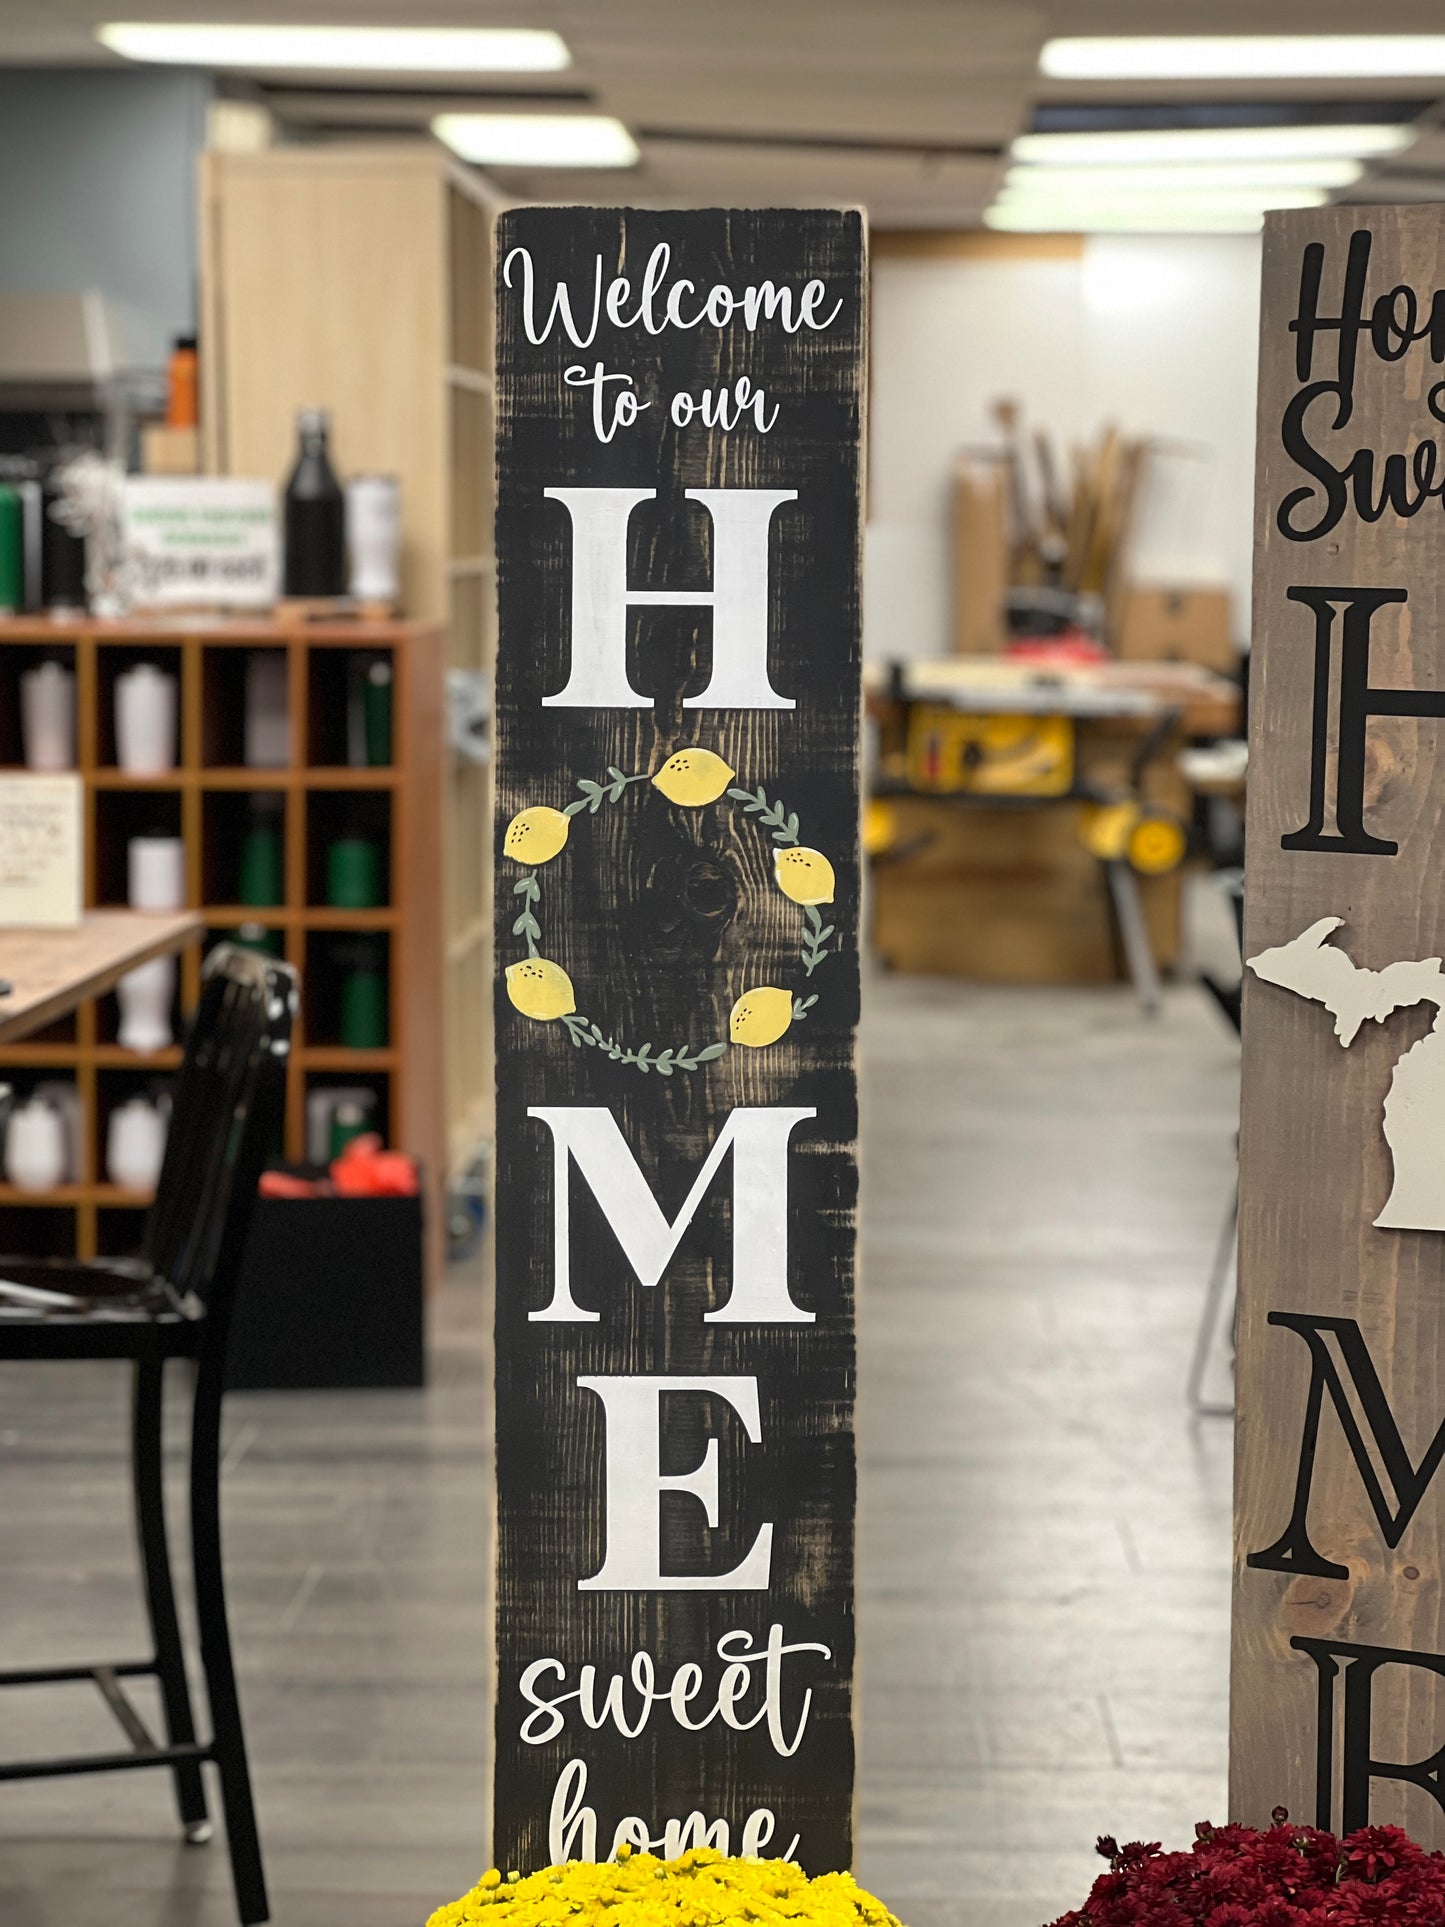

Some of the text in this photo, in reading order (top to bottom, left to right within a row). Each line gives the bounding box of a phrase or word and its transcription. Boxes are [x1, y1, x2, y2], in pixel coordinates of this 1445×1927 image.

[503, 242, 844, 349] Welcome
[1288, 229, 1445, 391] Ho
[563, 361, 780, 444] to our
[1276, 380, 1445, 543] Sw
[519, 1623, 832, 1757] sweet
